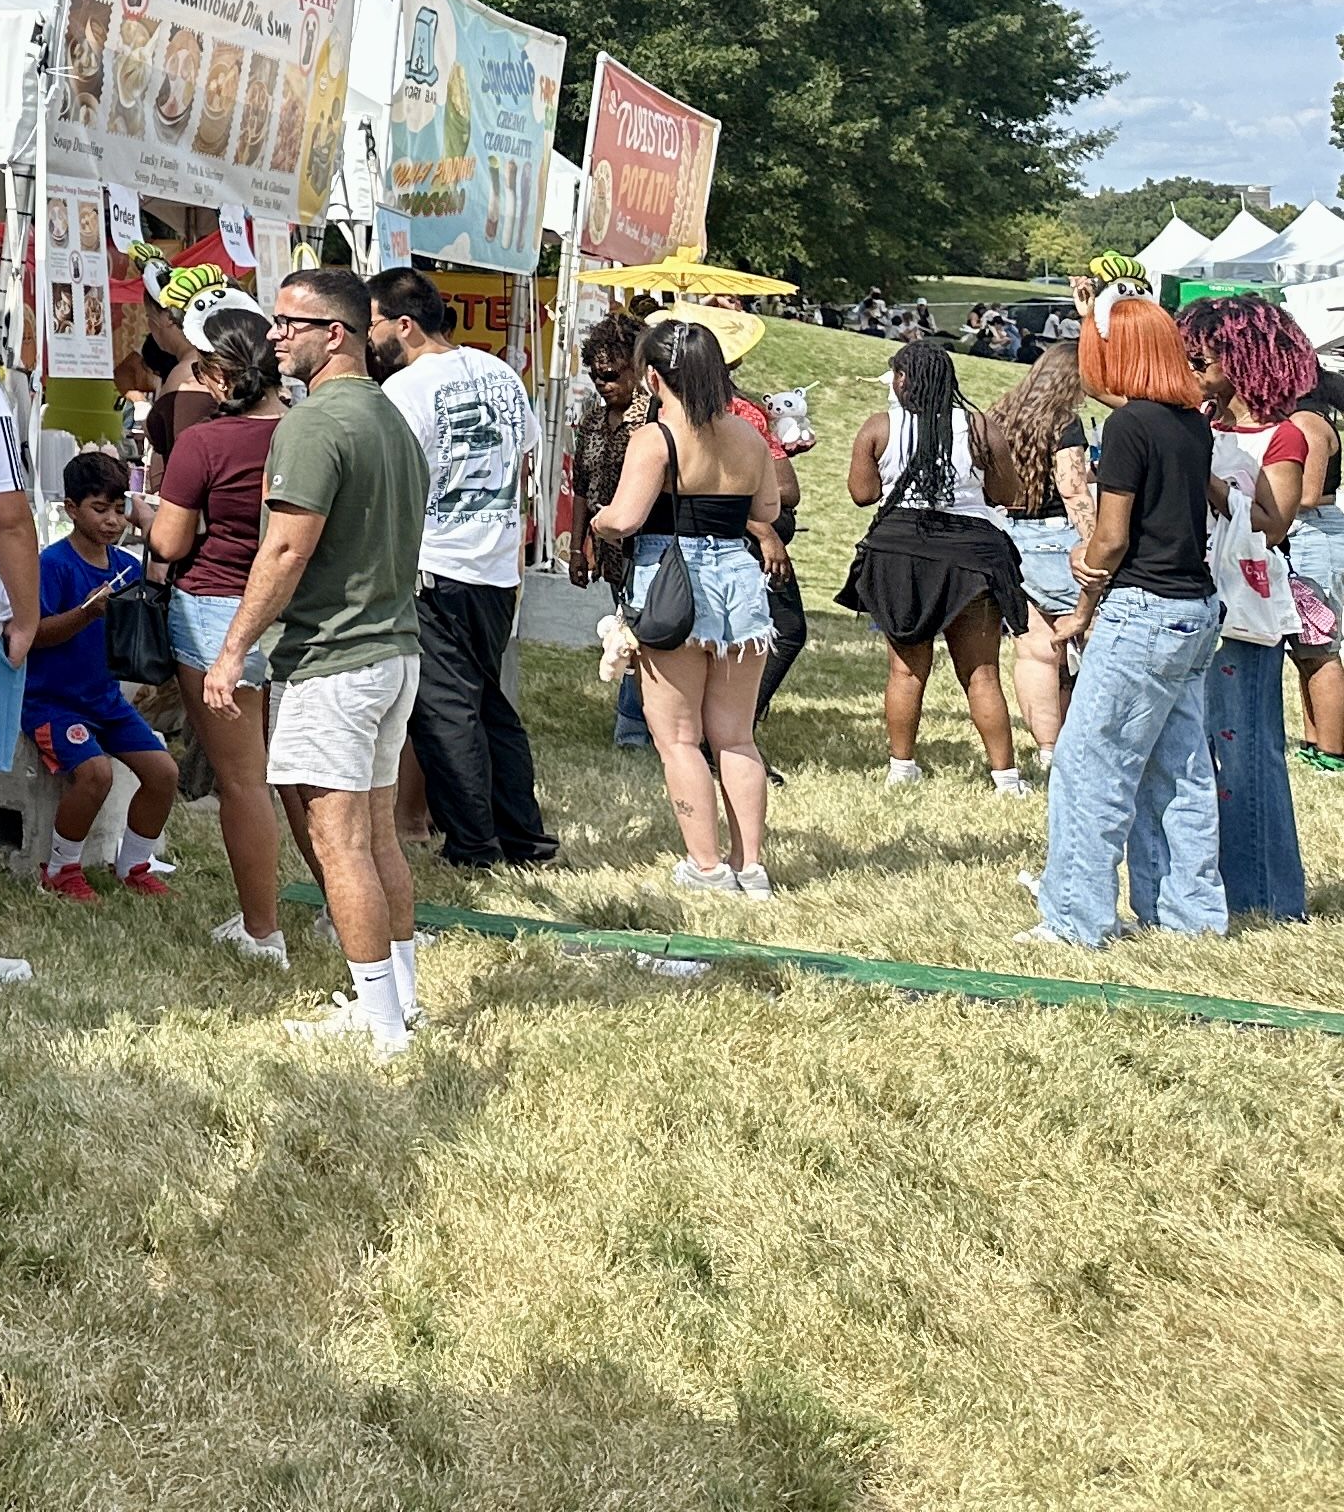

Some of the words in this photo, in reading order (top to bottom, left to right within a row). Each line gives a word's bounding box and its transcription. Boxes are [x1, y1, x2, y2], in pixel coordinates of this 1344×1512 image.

[241, 0, 263, 37] Dim
[267, 10, 292, 44] Sum
[483, 131, 512, 155] CLOUD
[616, 100, 680, 161] TWISTED
[52, 132, 72, 153] Soup
[72, 136, 104, 161] Dumpling
[616, 163, 670, 216] POTATO
[113, 203, 136, 227] Order
[220, 219, 233, 234] Pick
[233, 221, 243, 237] Up
